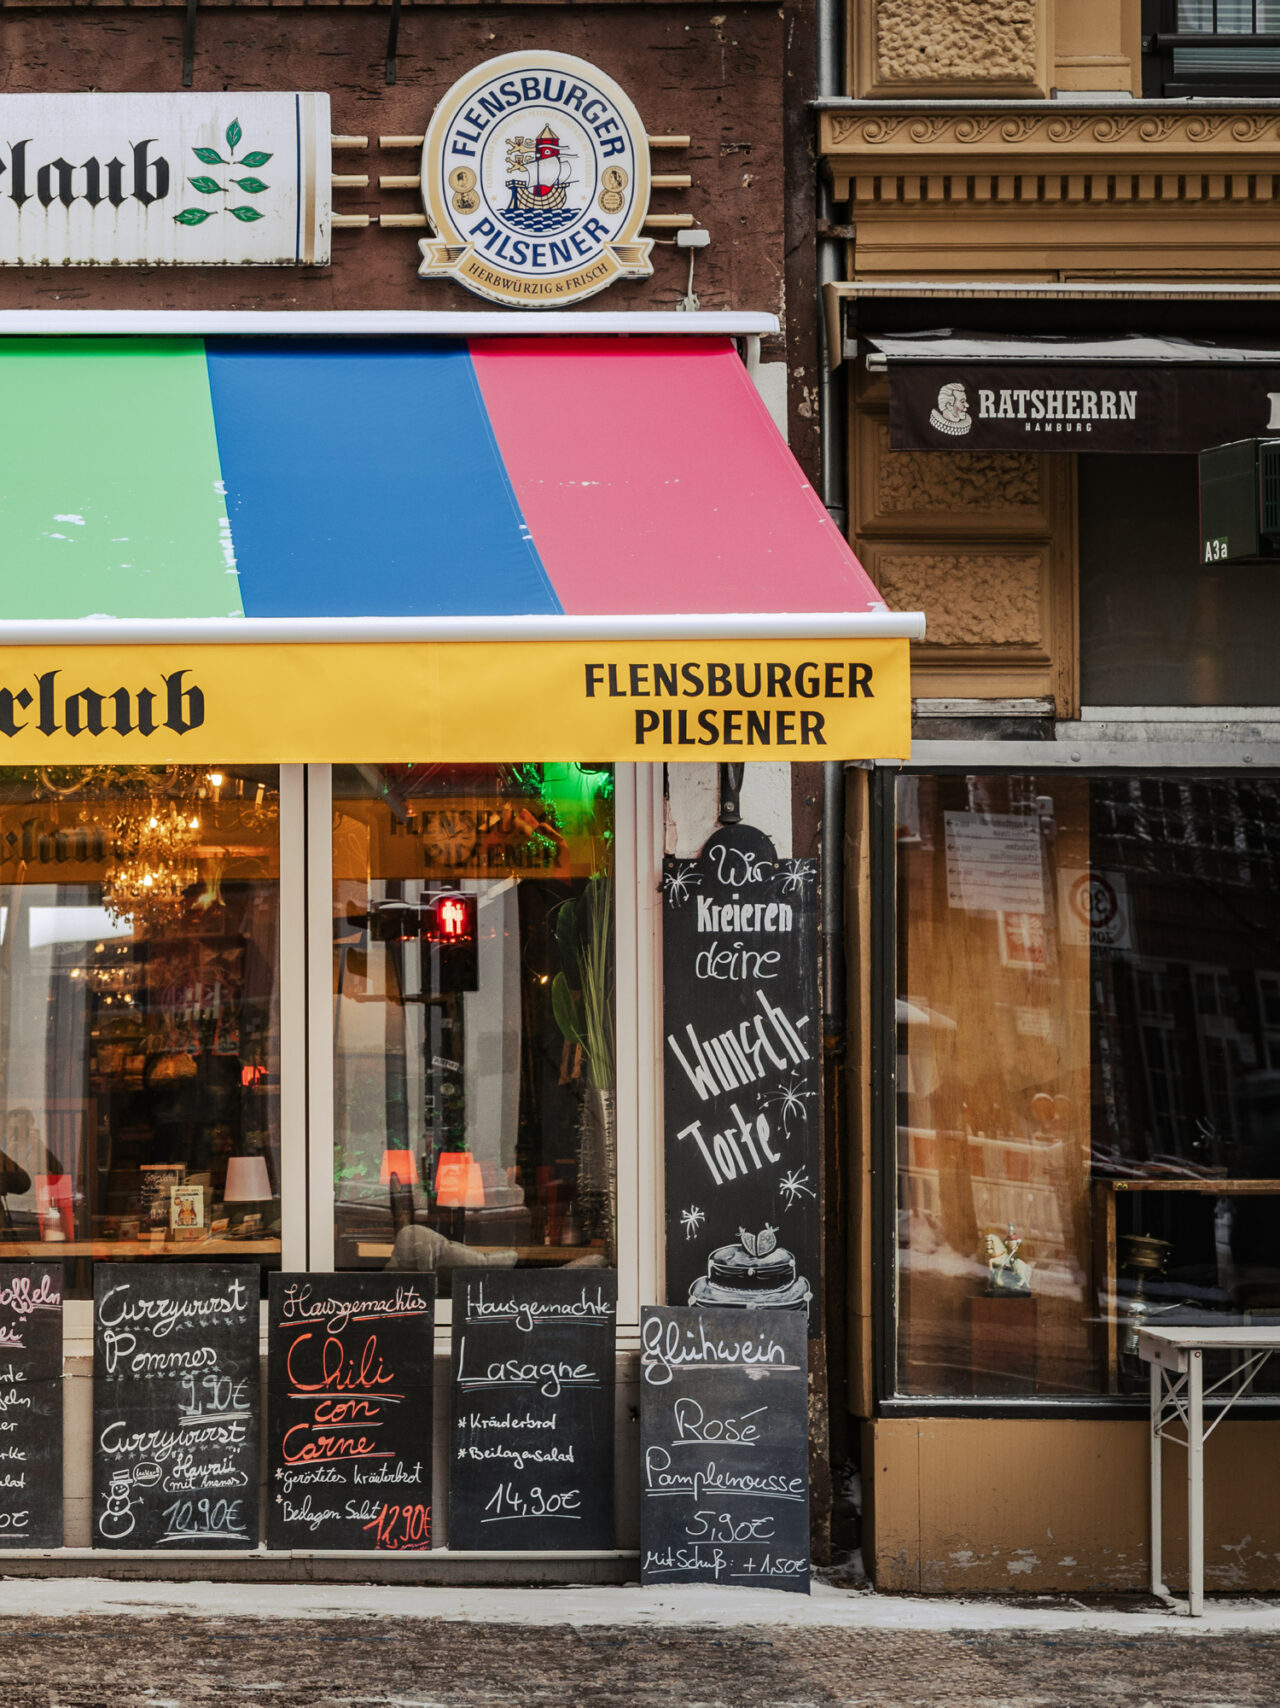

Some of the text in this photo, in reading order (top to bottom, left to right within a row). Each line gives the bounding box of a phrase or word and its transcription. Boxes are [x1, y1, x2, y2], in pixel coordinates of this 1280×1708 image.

[451, 76, 625, 158] FLENSBURGER
[469, 216, 609, 267] PILSENER
[468, 262, 608, 294] HERBWÜRZIG & FRISCH
[978, 389, 1137, 420] RATSHERRN
[1024, 422, 1093, 432] HAMBURG
[1204, 540, 1228, 563] A3a
[584, 662, 875, 698] FLENSBURGER
[634, 708, 827, 745] PILSENER
[709, 844, 773, 887] Wir
[695, 941, 781, 981] deine
[667, 989, 810, 1100] Wunsch-
[677, 1103, 781, 1185] Torte
[99, 1278, 247, 1338] Currywurst
[283, 1283, 428, 1334] Hausgemachtes
[465, 1281, 616, 1332] Hausgemachte
[104, 1330, 217, 1373] Pommes
[287, 1333, 395, 1390] Chili
[457, 1336, 596, 1398] Lasagne
[642, 1316, 786, 1386] Glühwein
[315, 1400, 381, 1423] con
[674, 1398, 768, 1441] Rosé
[100, 1421, 246, 1463] Currywurst
[283, 1423, 375, 1462] Carne
[470, 1446, 575, 1469] Beilagensalat
[283, 1466, 348, 1493] Geröstetes
[645, 1446, 806, 1502] Pamplemousse
[162, 1498, 248, 1532] 10,90€
[283, 1495, 381, 1531] Beilagen Salat
[485, 1482, 581, 1516] 14,90€
[685, 1511, 776, 1543] 5,90€
